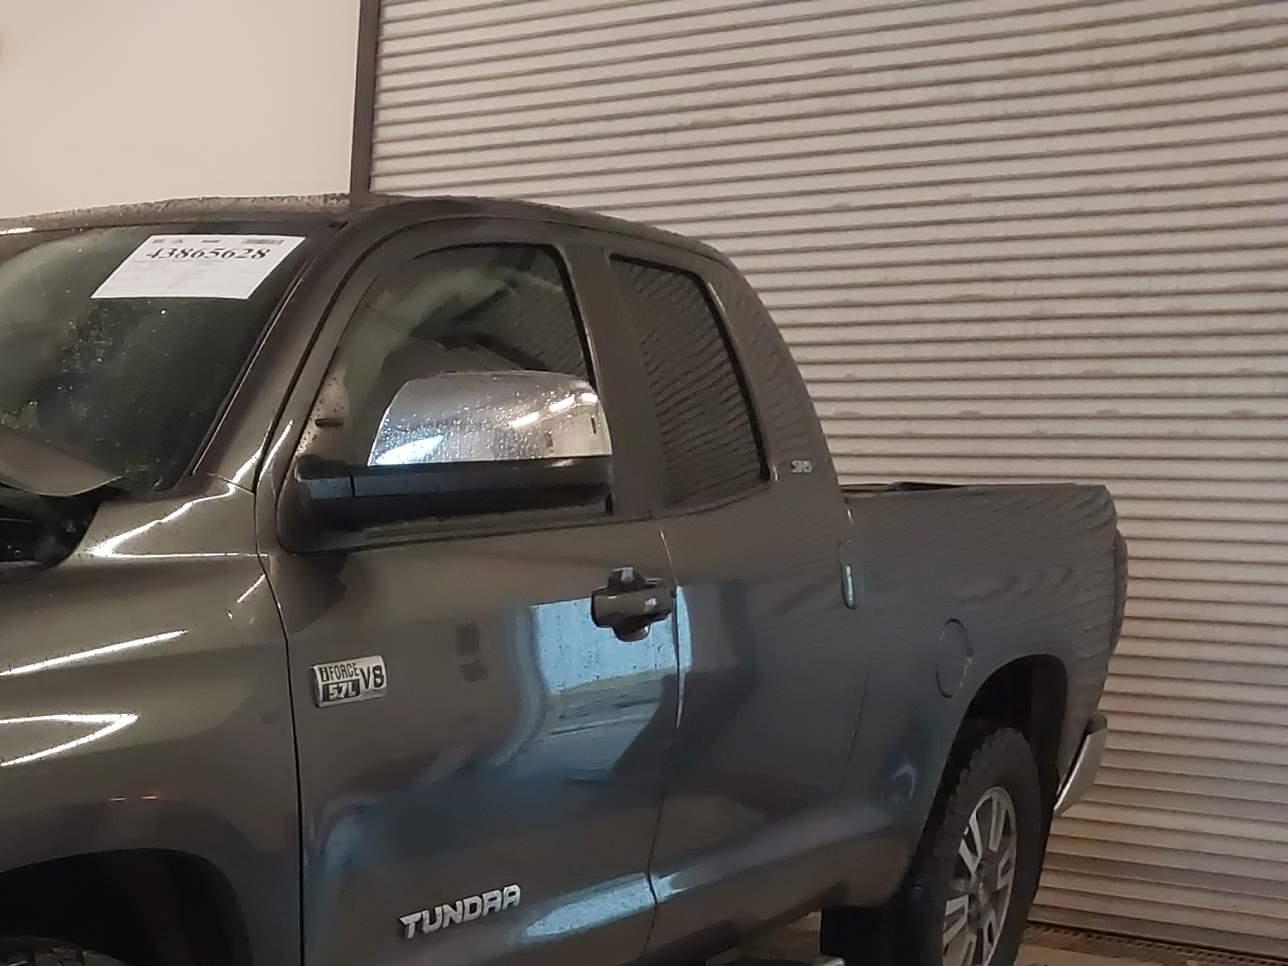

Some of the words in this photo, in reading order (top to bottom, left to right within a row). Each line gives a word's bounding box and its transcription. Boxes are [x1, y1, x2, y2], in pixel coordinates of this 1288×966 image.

[146, 247, 271, 260] 43865628
[359, 664, 385, 690] V8
[399, 884, 521, 940] TUNDRA
